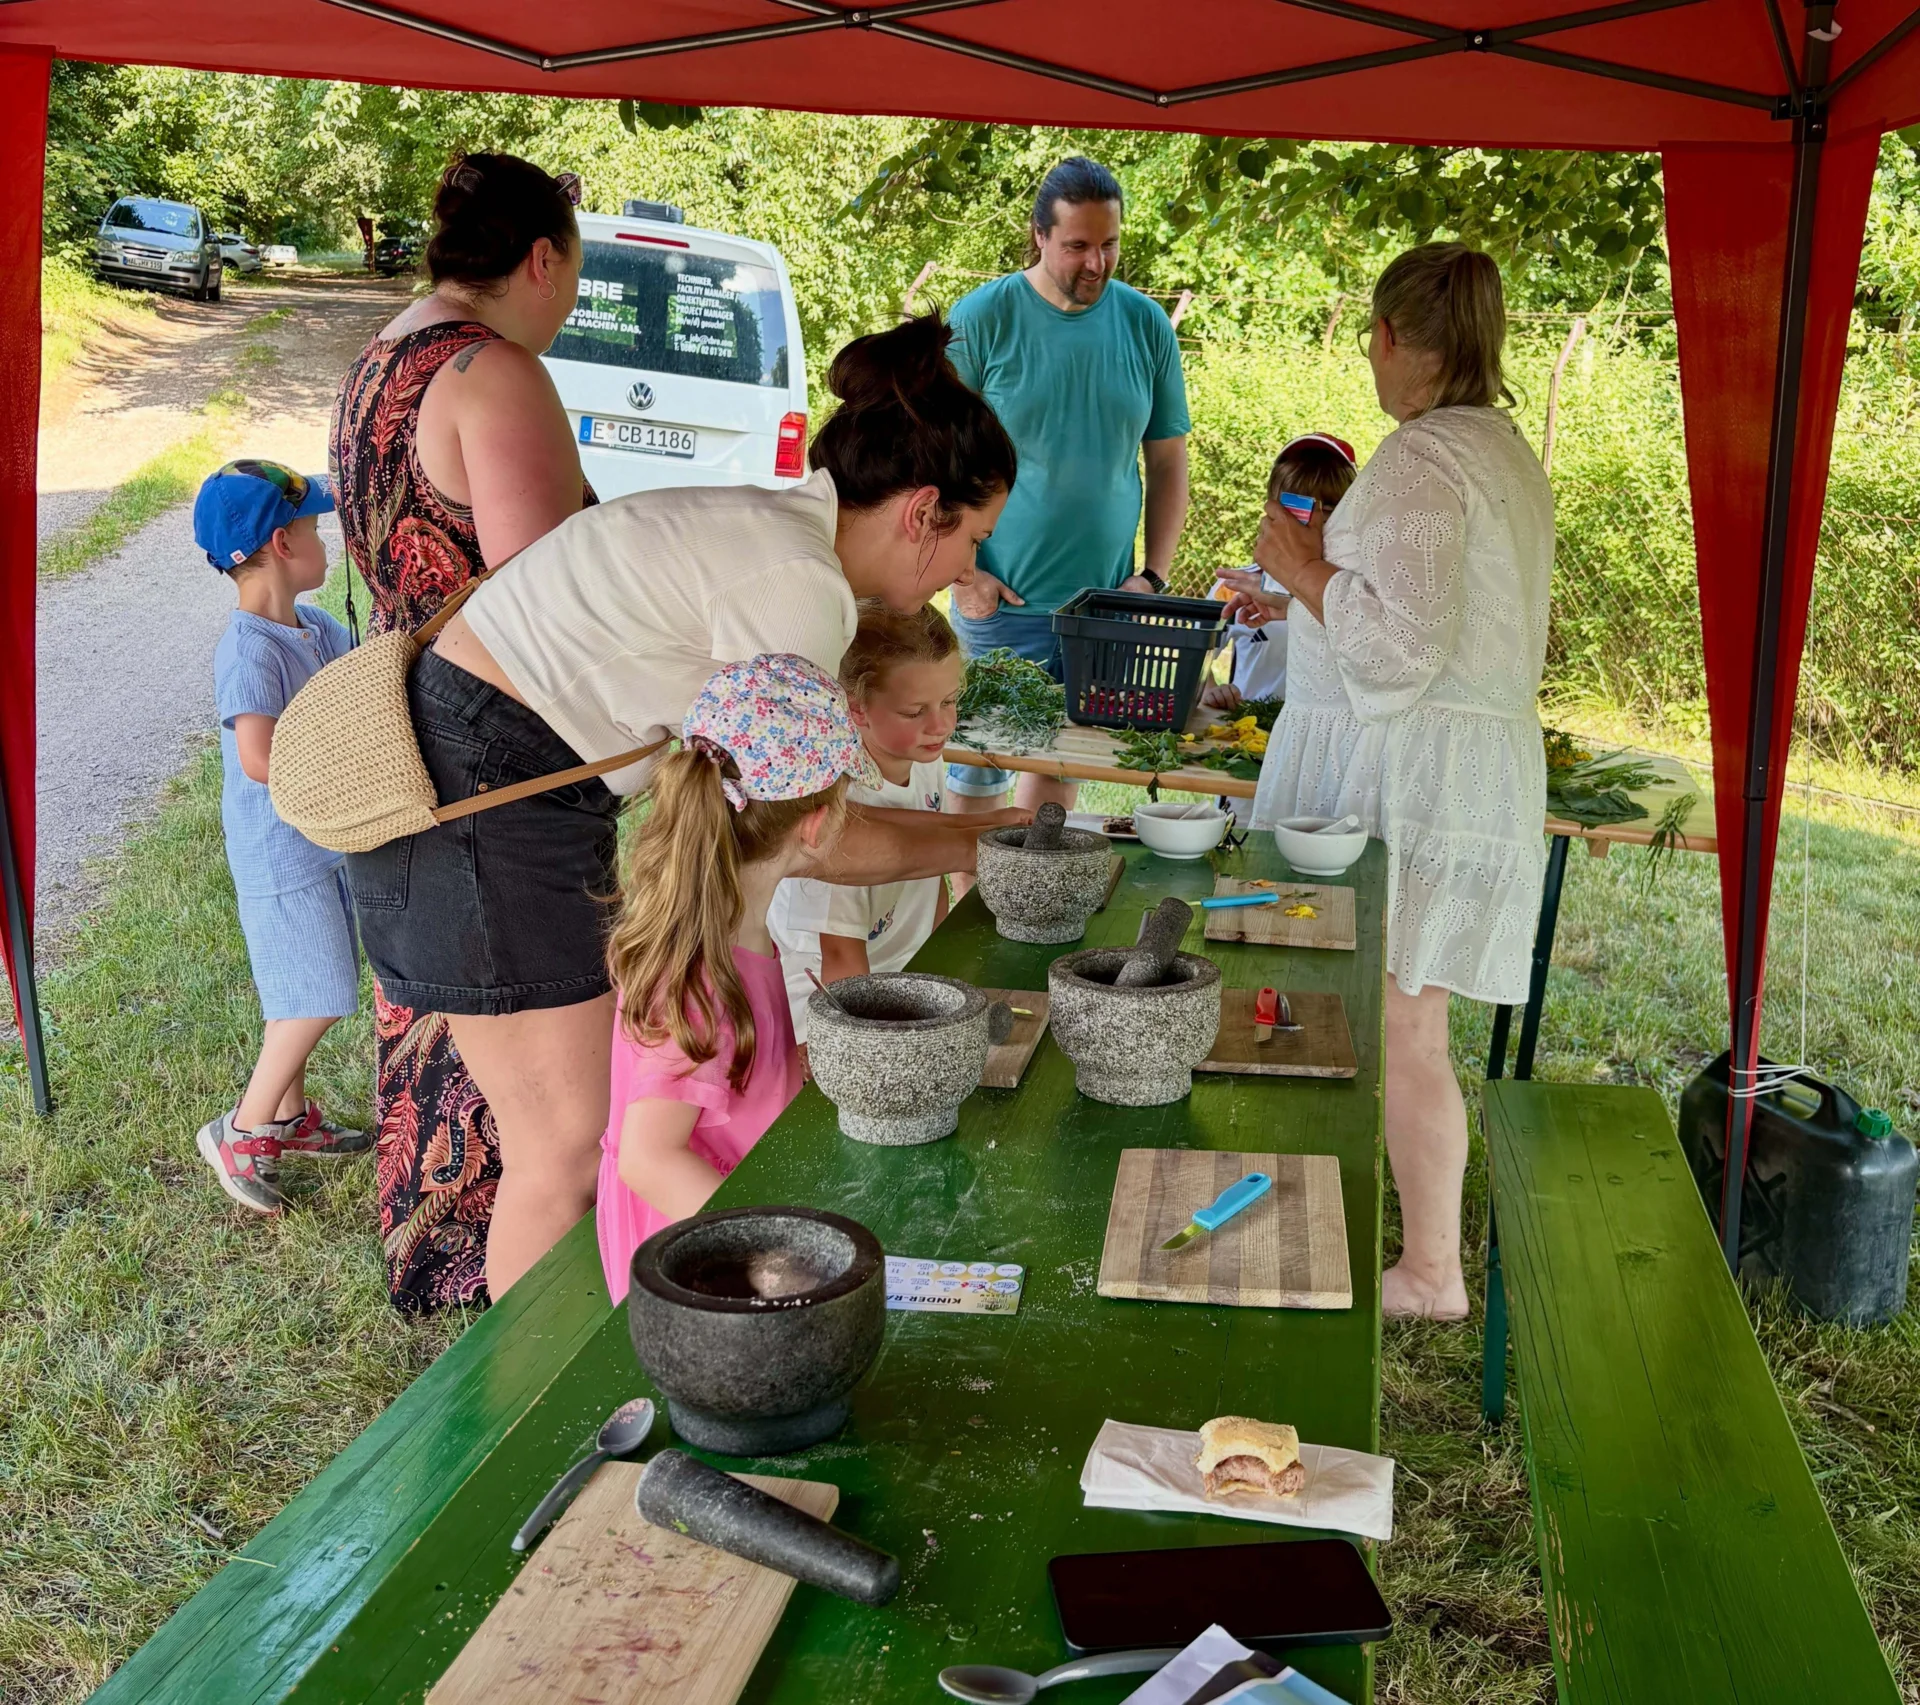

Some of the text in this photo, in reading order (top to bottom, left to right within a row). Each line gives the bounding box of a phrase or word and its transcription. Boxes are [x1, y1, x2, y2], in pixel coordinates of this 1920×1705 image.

[677, 273, 713, 287] TECHNIKER,
[676, 284, 704, 295] FACILITY
[704, 288, 735, 300] MANAGER
[676, 303, 734, 321] PROJECT MANAGER
[577, 319, 618, 332] MACHEN
[594, 421, 604, 440] E
[618, 425, 641, 444] CB
[646, 428, 692, 451] 1186
